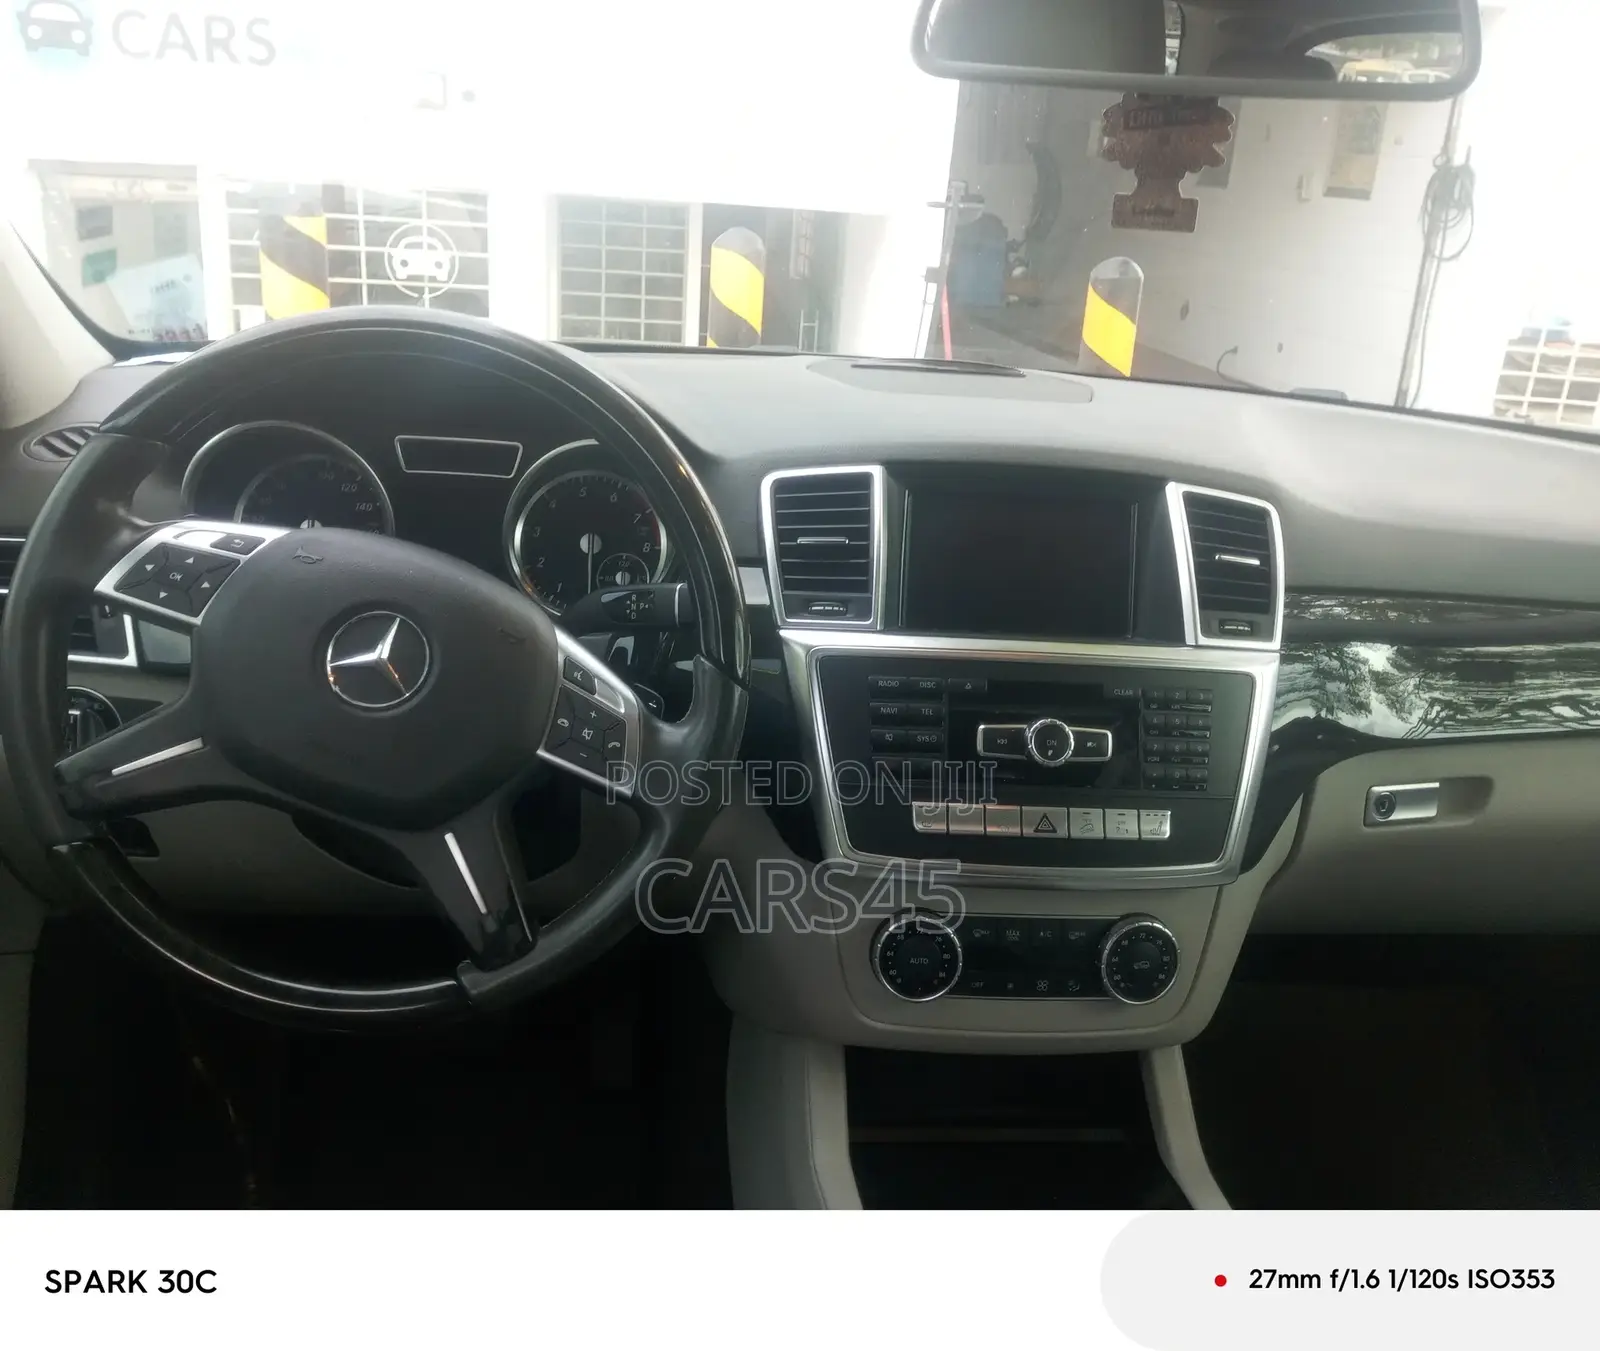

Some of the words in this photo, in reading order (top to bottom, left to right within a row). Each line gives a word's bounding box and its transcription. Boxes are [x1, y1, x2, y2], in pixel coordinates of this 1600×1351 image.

[341, 483, 358, 492] 120
[579, 487, 587, 497] 5
[610, 493, 618, 502] 6
[355, 502, 373, 512] 140
[633, 513, 642, 524] 7
[533, 527, 541, 537] 3
[643, 543, 651, 553] 8
[536, 557, 545, 567] 2
[169, 572, 183, 582] OK
[556, 582, 563, 593] 1
[631, 603, 637, 611] N
[631, 612, 637, 620] D
[878, 679, 900, 688] RADIO
[919, 681, 937, 689] DISC
[1113, 688, 1134, 696] CLEAR
[880, 706, 898, 714] NAVI
[921, 708, 933, 716] TEL
[917, 735, 930, 743] SYS
[1046, 739, 1058, 747] ON
[910, 957, 929, 965] AUTO
